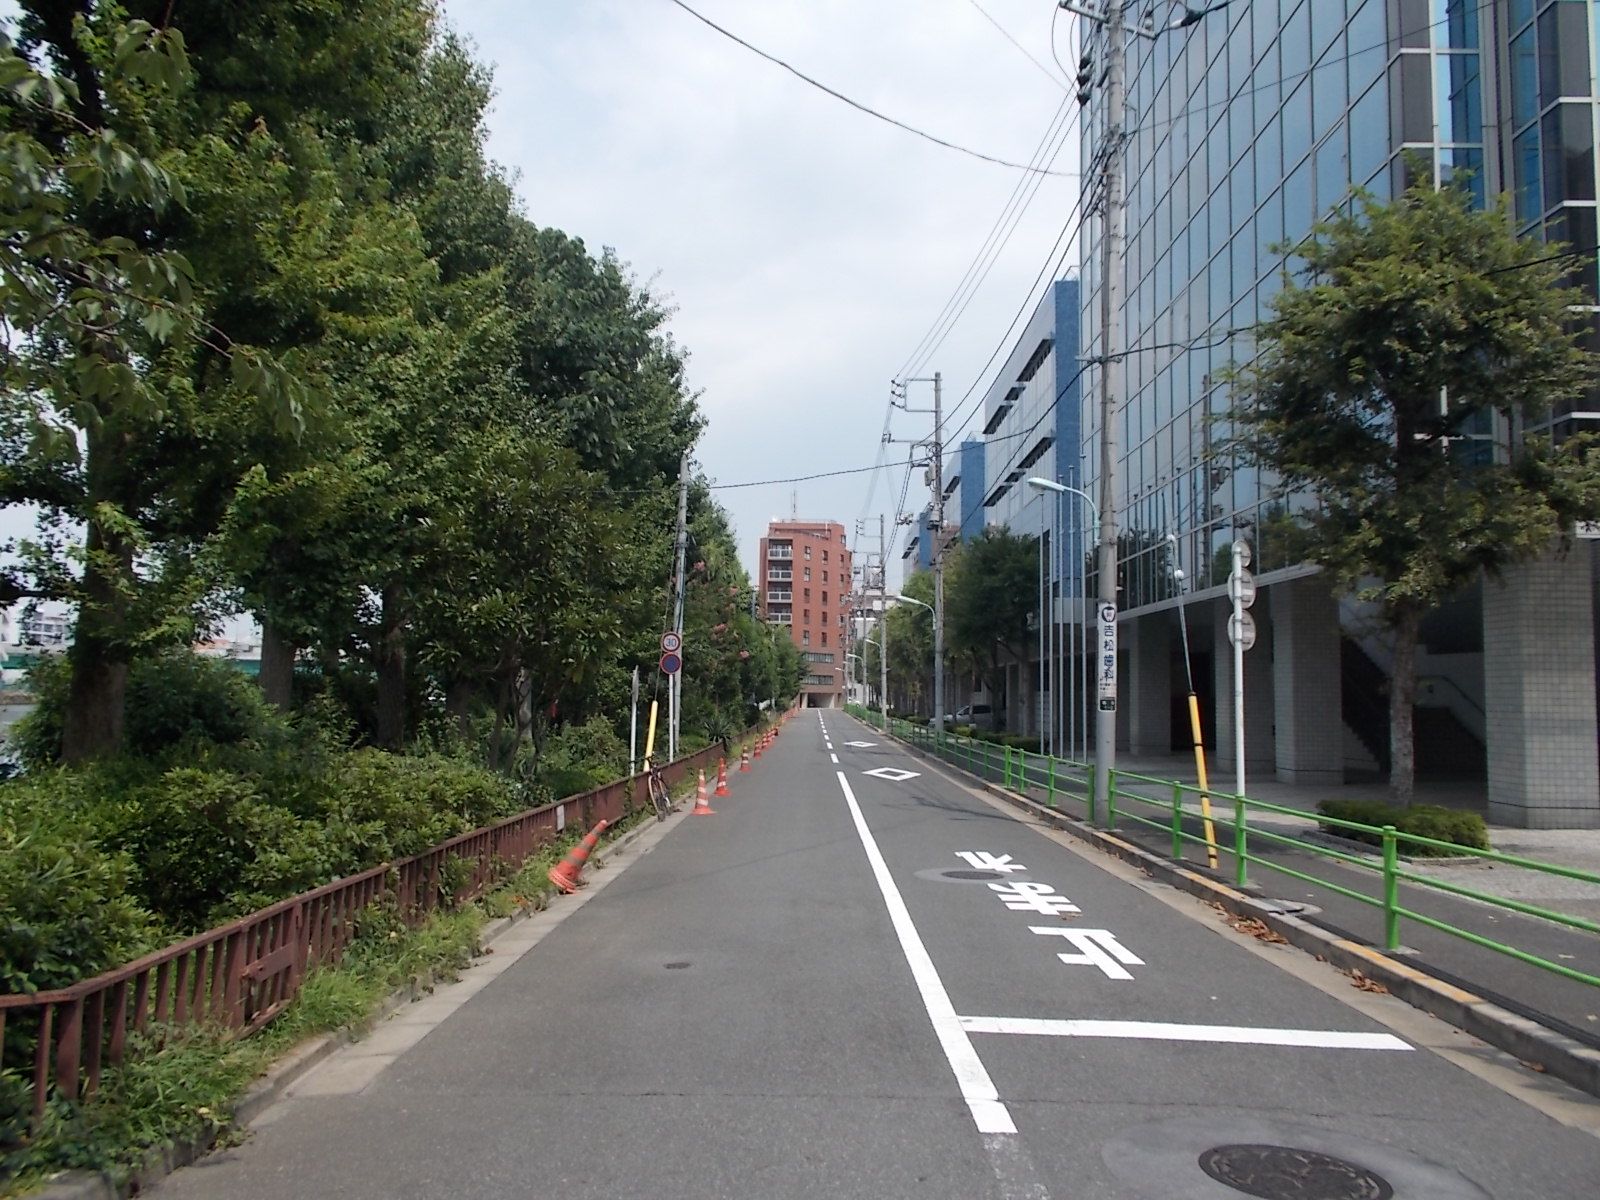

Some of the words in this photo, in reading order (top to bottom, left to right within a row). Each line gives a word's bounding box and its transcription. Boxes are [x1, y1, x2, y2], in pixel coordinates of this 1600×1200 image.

[665, 637, 677, 648] 30
[954, 851, 1146, 980] 止まれ
